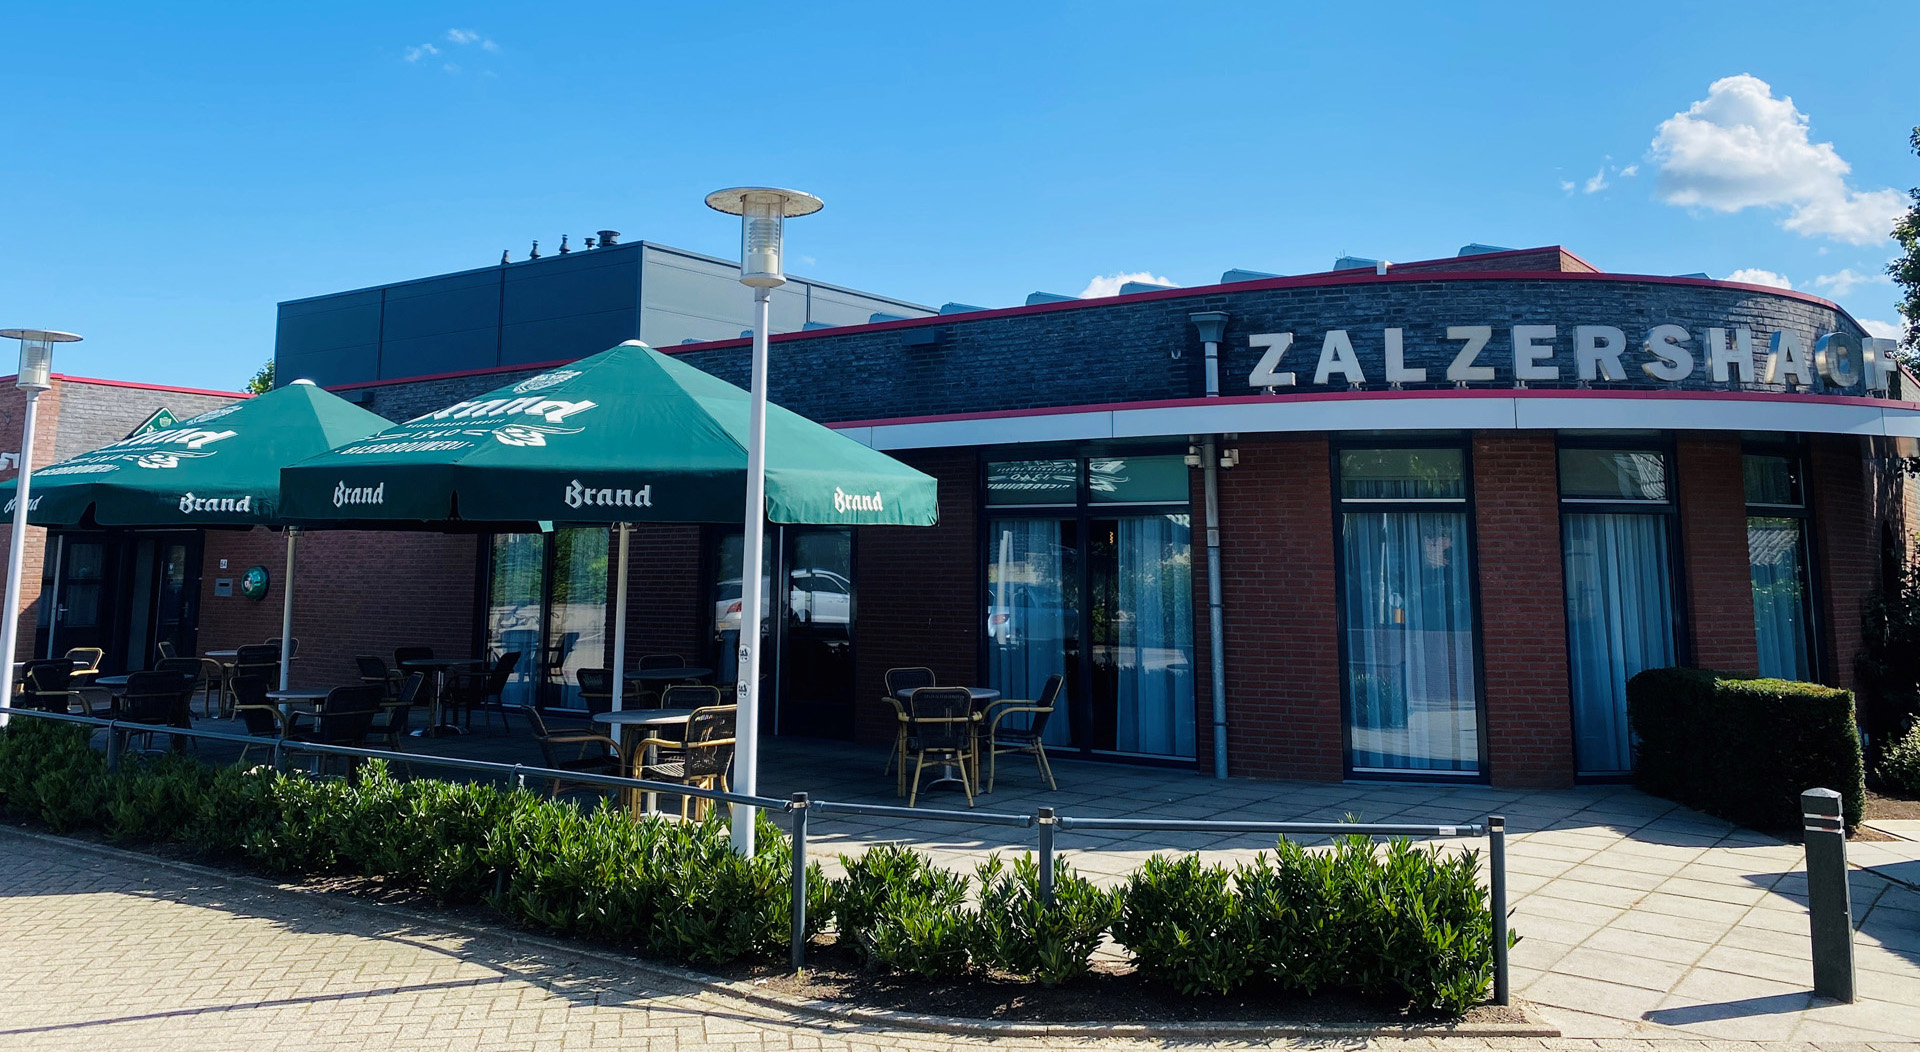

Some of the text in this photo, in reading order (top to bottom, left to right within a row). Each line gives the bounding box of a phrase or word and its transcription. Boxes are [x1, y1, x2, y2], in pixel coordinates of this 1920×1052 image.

[1249, 324, 1897, 390] ZALZERSHAOF
[178, 491, 251, 514] Brand
[332, 480, 384, 508] Brand
[564, 479, 652, 509] Brand
[833, 486, 884, 514] Brand
